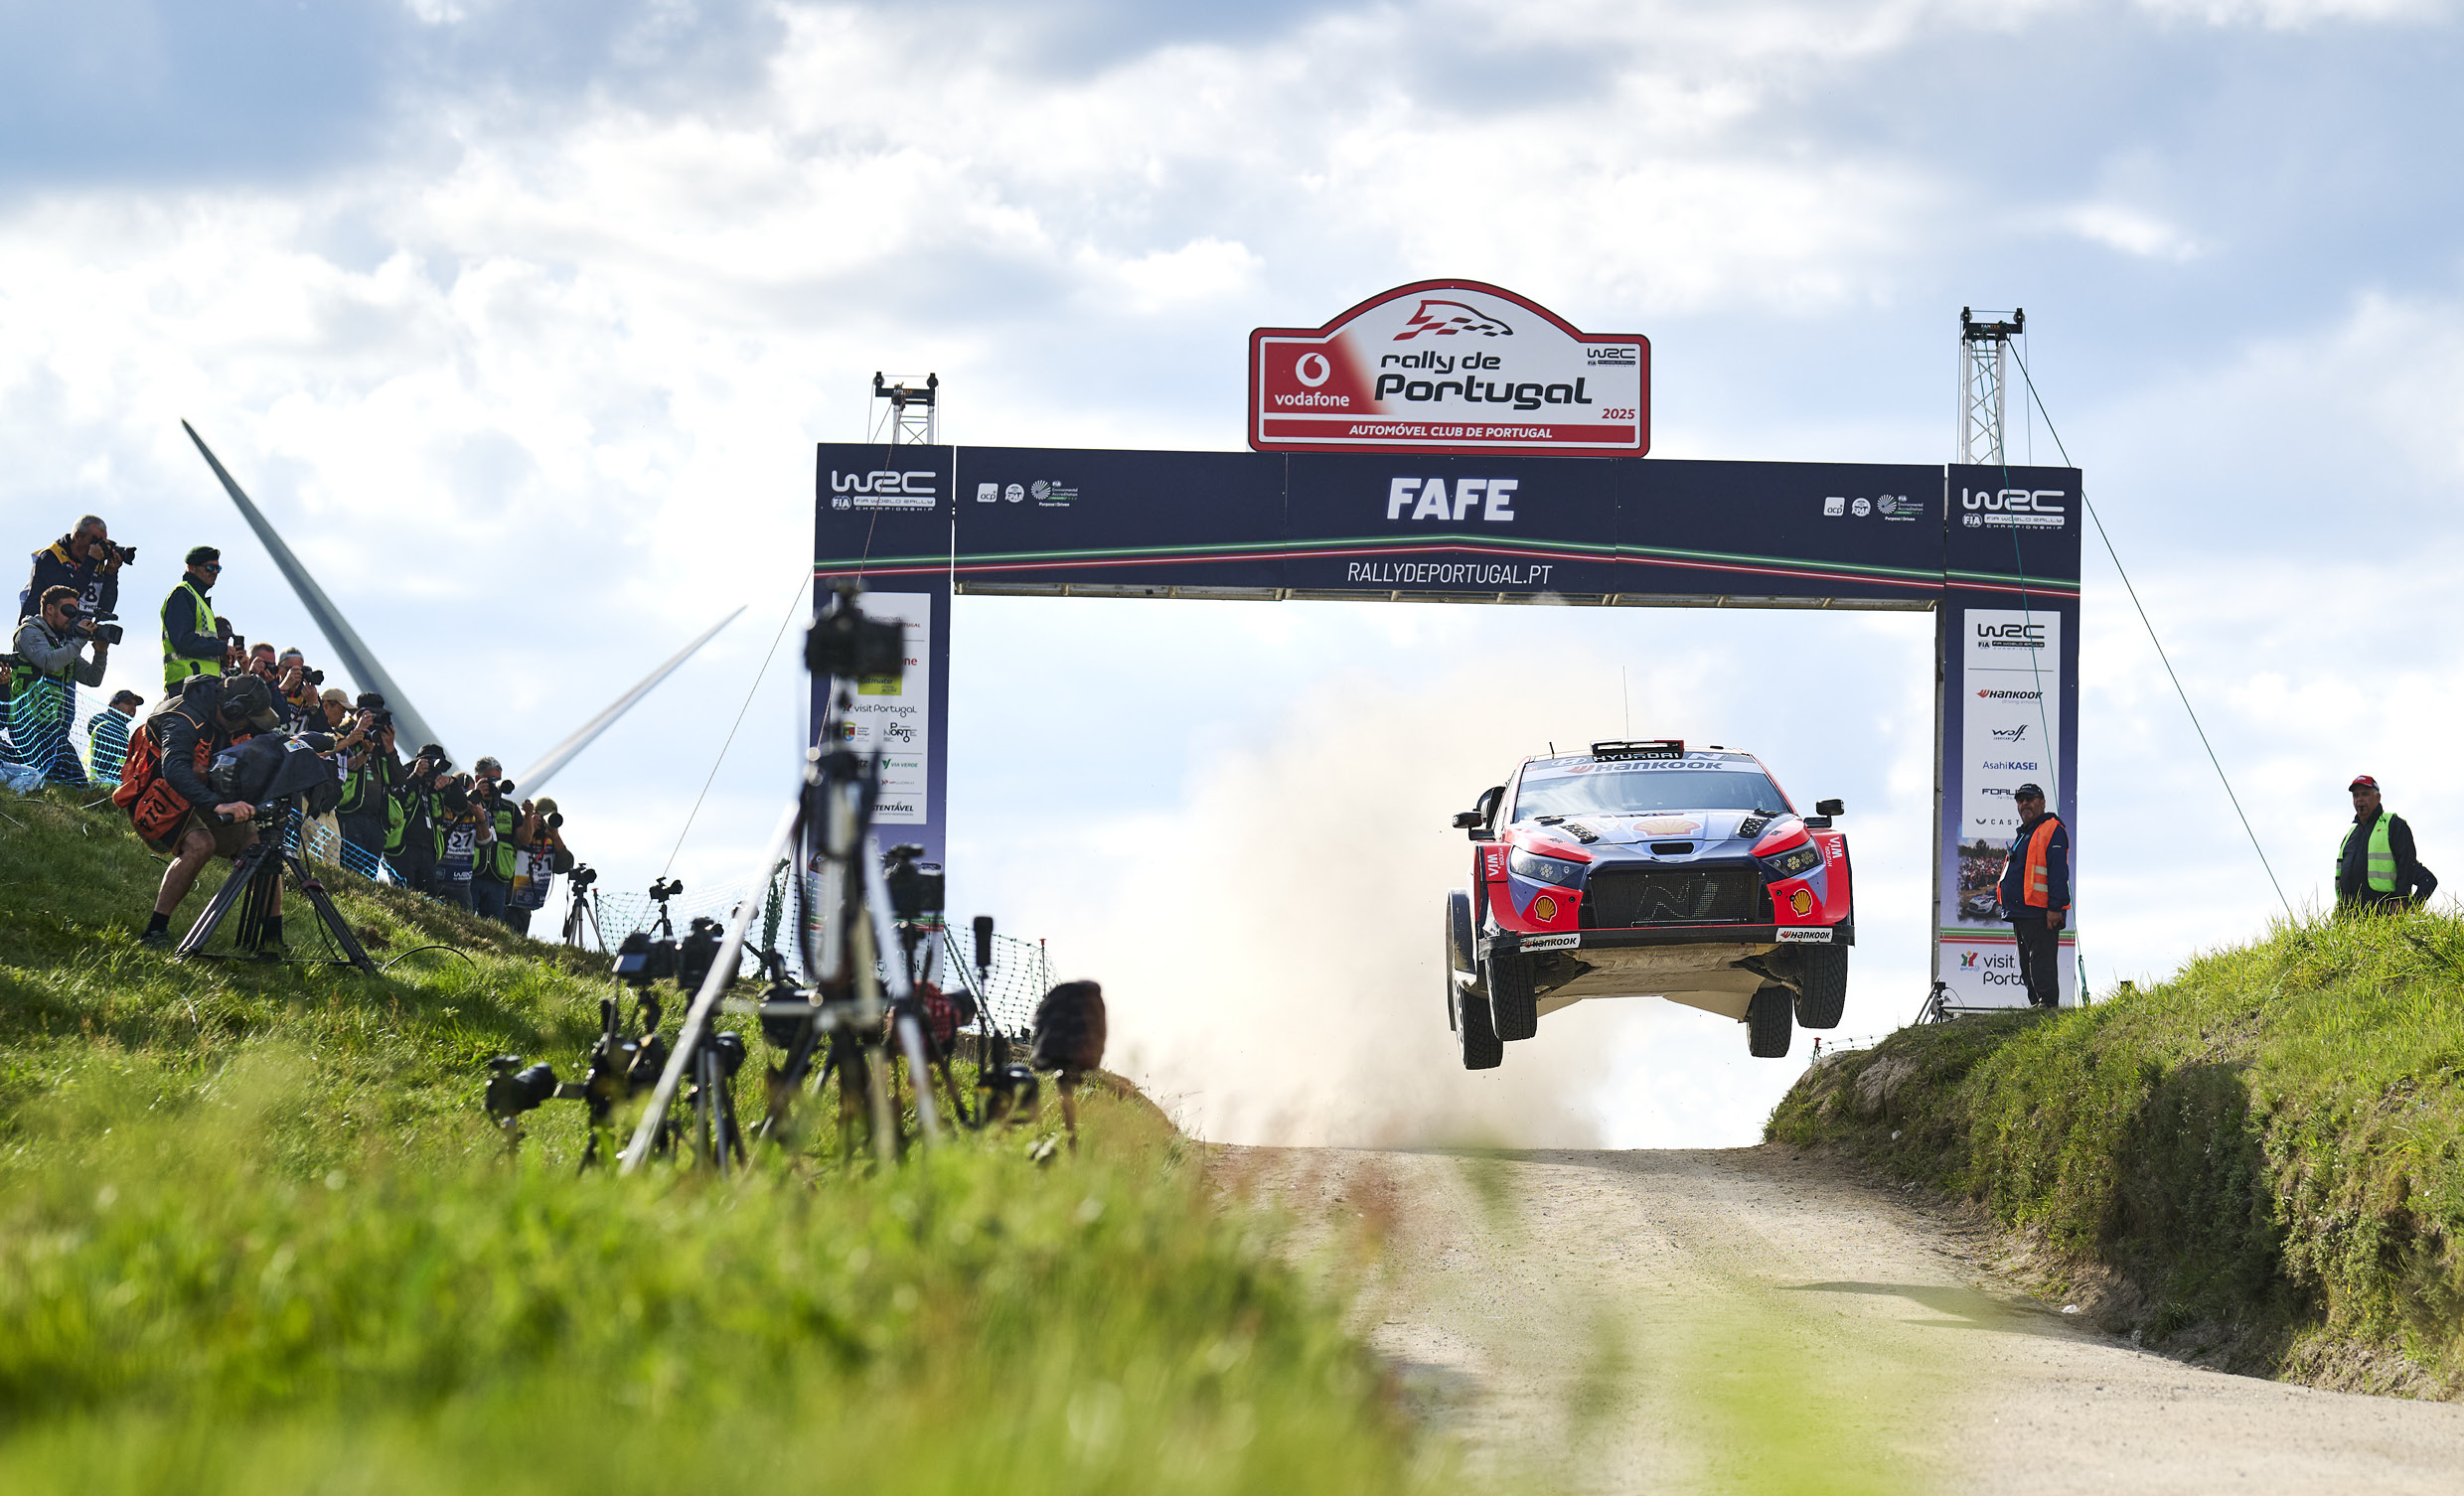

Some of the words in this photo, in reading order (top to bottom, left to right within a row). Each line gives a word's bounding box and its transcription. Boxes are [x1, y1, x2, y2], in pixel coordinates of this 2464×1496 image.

[1587, 348, 1635, 359] WRC
[1381, 351, 1455, 374] rally
[1462, 352, 1501, 371] de
[1275, 391, 1350, 407] vodafone
[1374, 374, 1593, 410] Portugal
[1602, 408, 1636, 419] 2025
[1349, 423, 1428, 436] AUTOMÓVEL
[1430, 426, 1463, 437] CLUB
[1465, 427, 1483, 437] DE
[1485, 427, 1553, 438] PORTUGAL
[832, 470, 936, 494] WRC
[833, 498, 850, 509] FIA
[1387, 478, 1519, 522] FAFE
[1962, 488, 2065, 513] WRC
[1963, 515, 1982, 526] FIA
[1347, 562, 1553, 584] RALLYDEPORTUGAL.PT
[1978, 623, 2045, 639] WRC
[874, 704, 916, 718] Portugal
[1983, 954, 2015, 969] visit
